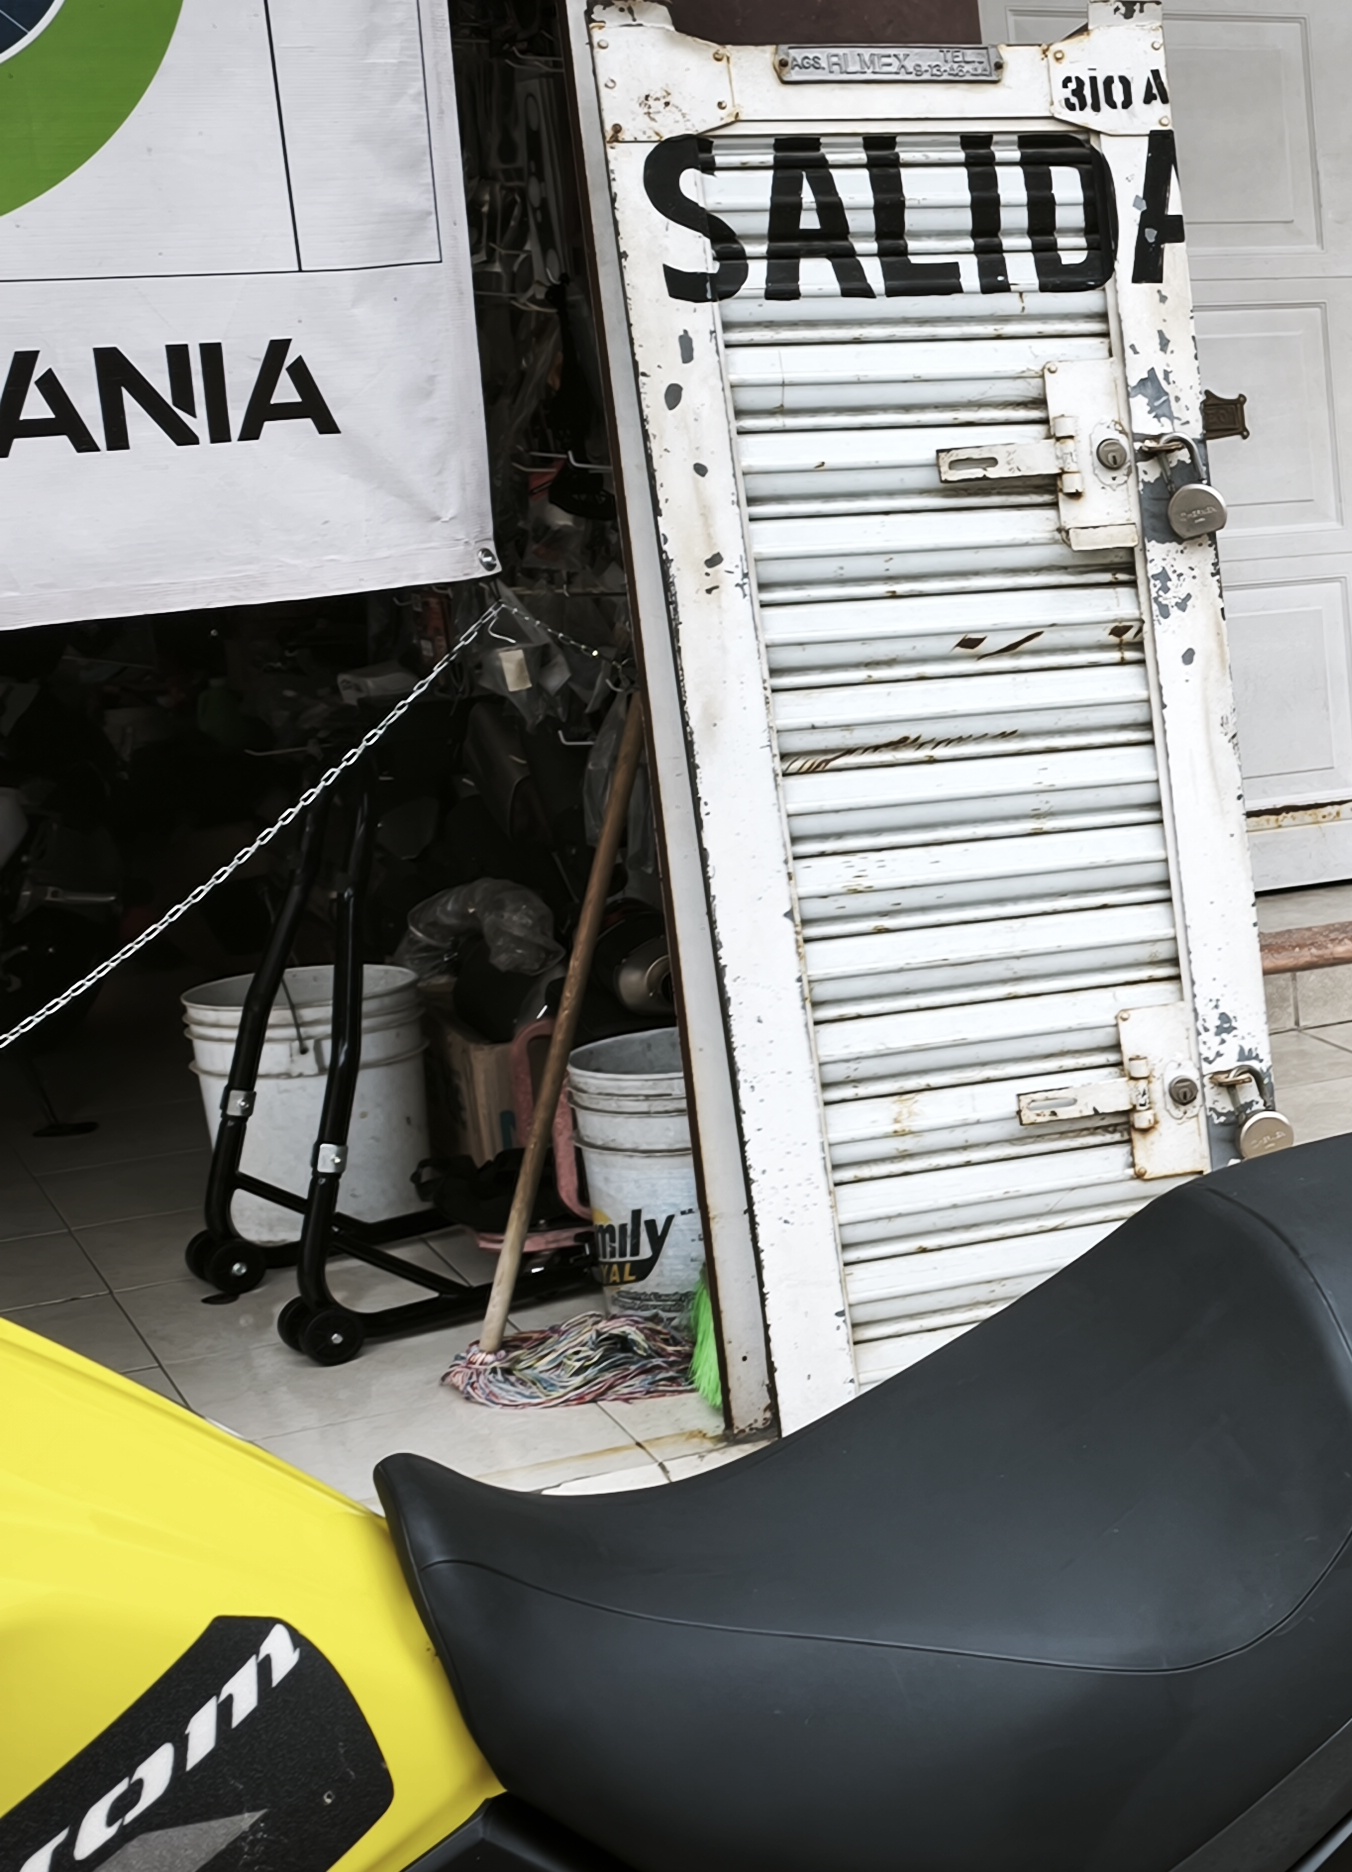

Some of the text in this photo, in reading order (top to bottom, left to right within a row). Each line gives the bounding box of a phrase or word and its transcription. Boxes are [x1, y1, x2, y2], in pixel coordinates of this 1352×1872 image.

[1061, 68, 1170, 113] 310 A
[643, 130, 1185, 303] SALIDA
